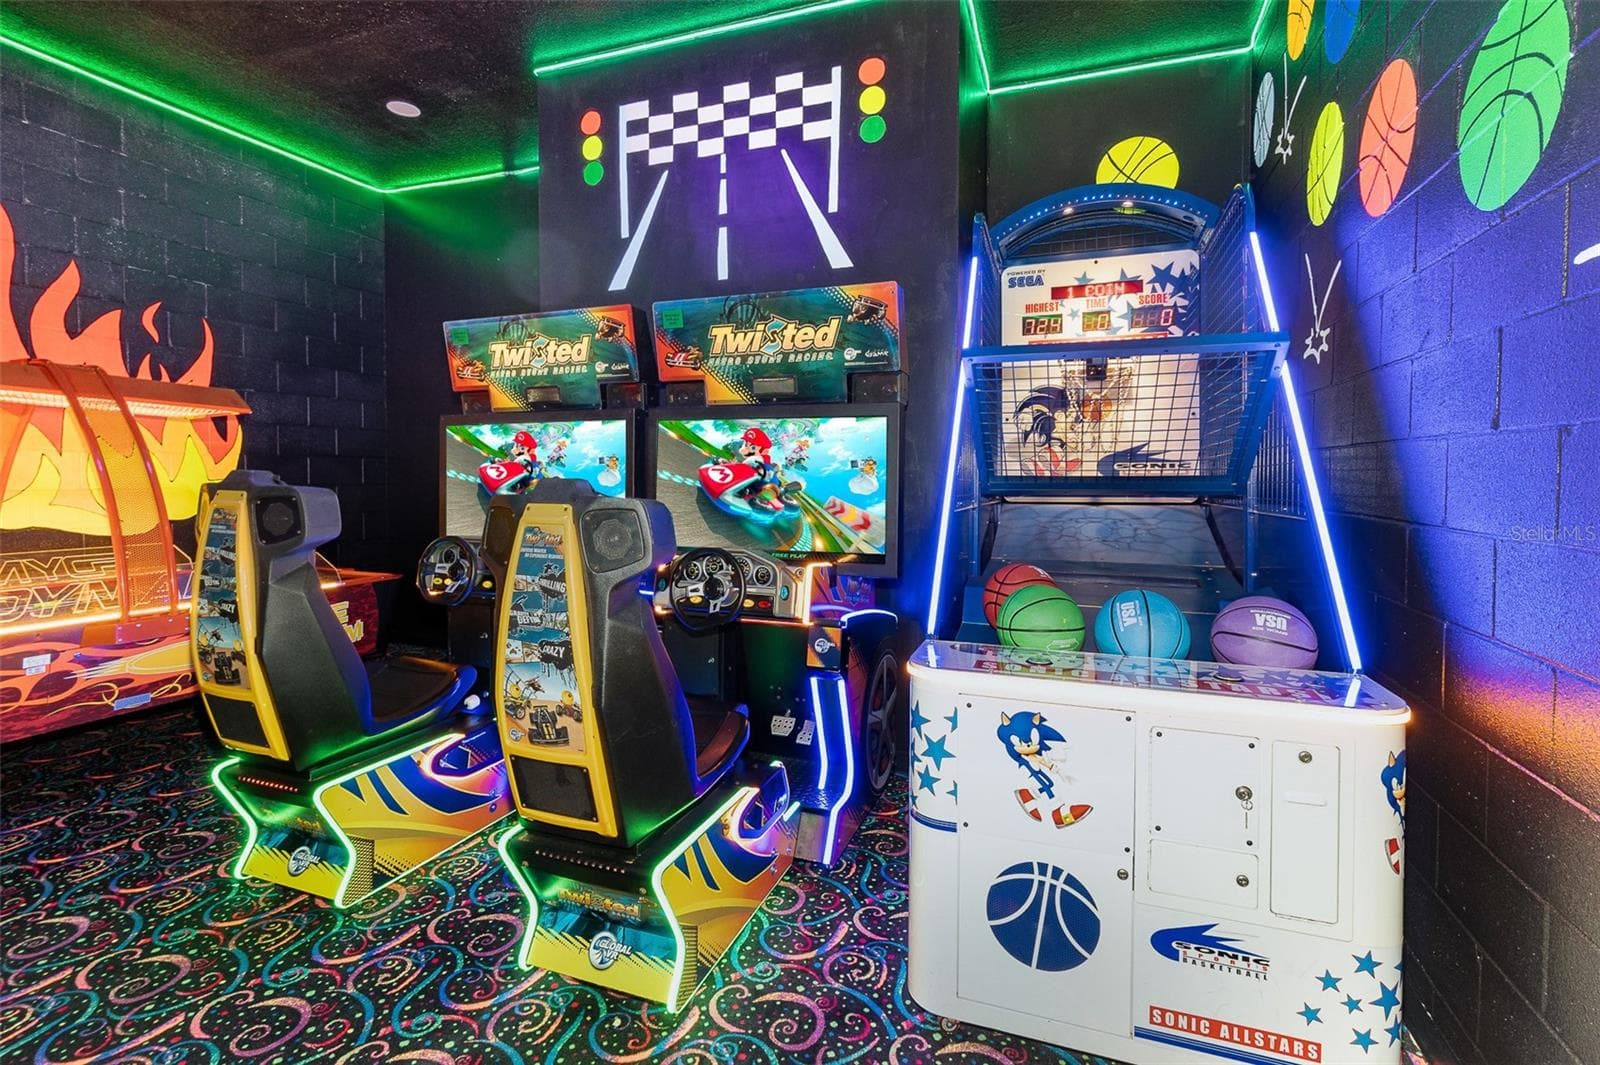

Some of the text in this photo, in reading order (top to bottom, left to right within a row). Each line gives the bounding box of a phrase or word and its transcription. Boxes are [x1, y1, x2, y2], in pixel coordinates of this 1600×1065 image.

[1007, 275, 1044, 288] SEGA
[1025, 303, 1060, 314] HIGHEST
[1086, 299, 1107, 309] TIME
[1138, 294, 1169, 305] SCORE
[708, 315, 843, 358] Twisted
[489, 333, 592, 369] Twisted
[1120, 601, 1138, 627] USA
[1254, 613, 1287, 631] USA
[598, 938, 633, 956] GLOBAL
[606, 949, 619, 960] VR
[1174, 941, 1271, 967] SONIC
[1182, 957, 1269, 981] BASKETBALL
[1152, 1008, 1319, 1060] SONIC ALLSTARS
